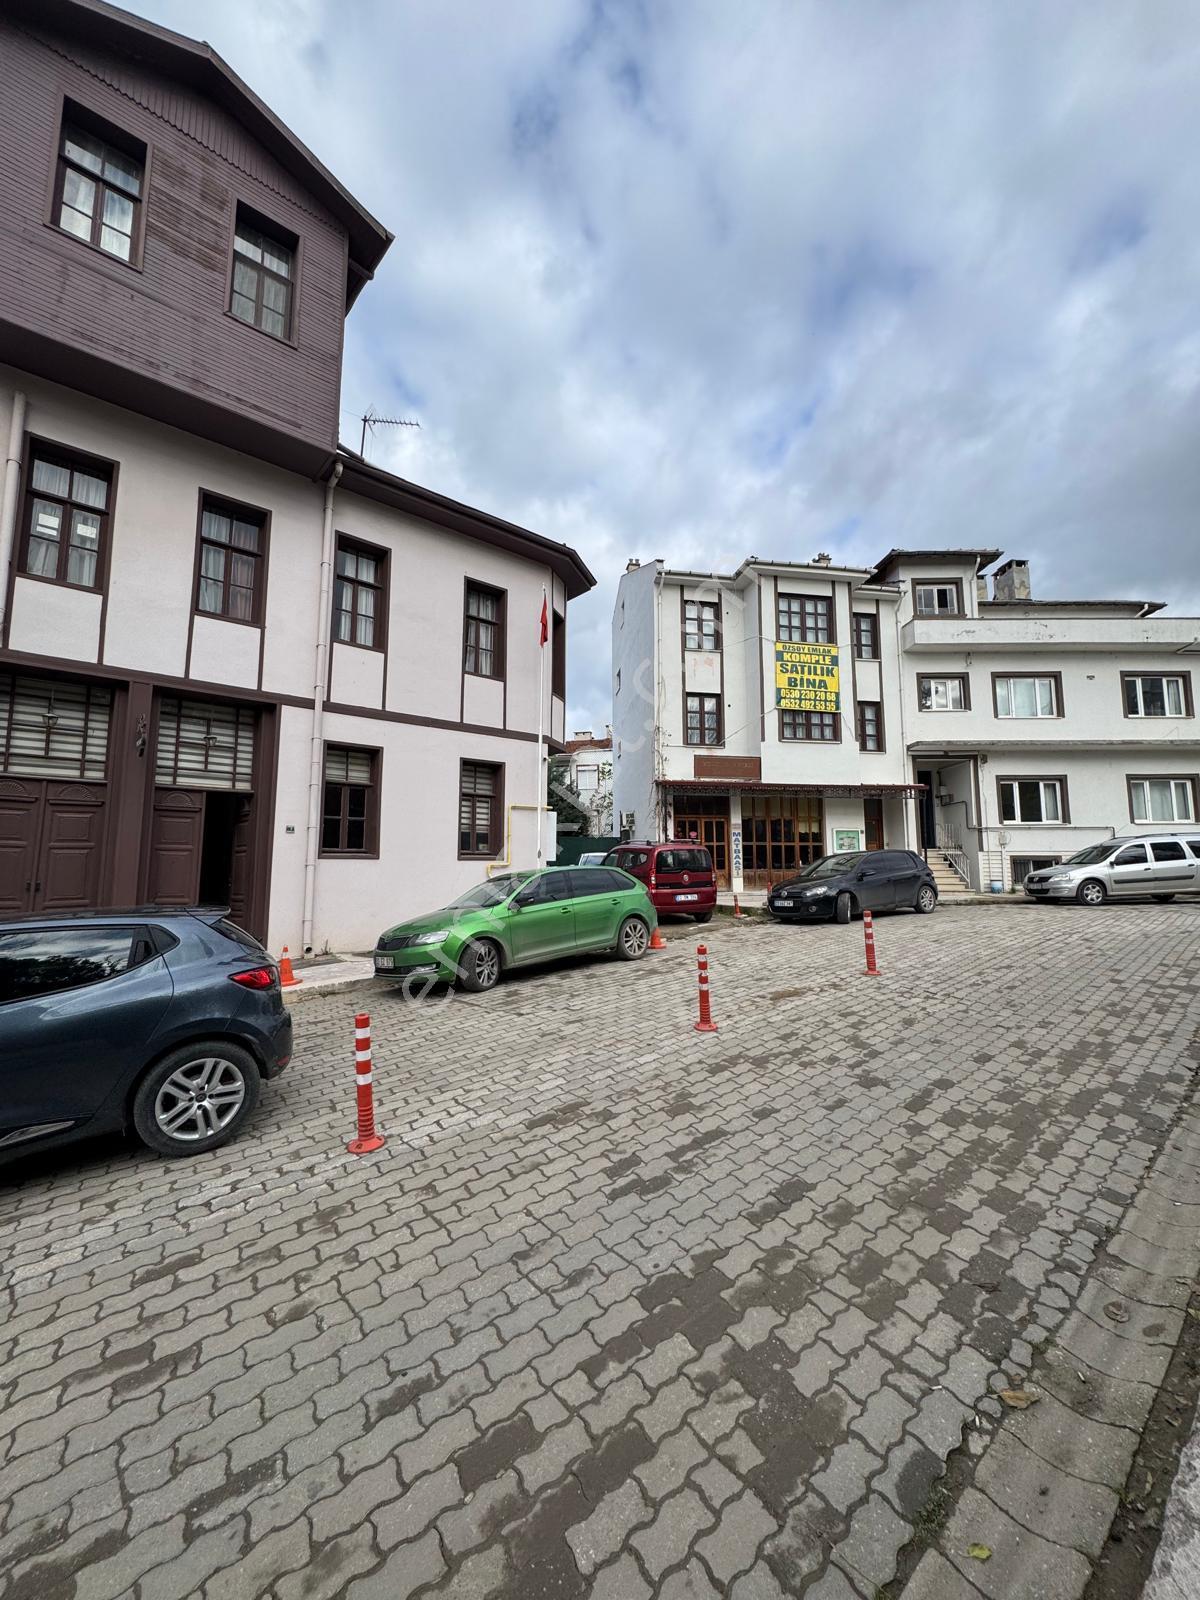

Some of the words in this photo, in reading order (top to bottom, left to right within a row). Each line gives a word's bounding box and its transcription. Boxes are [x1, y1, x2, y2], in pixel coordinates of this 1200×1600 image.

[807, 646, 832, 655] EMLAK
[783, 652, 832, 665] KOMPLE
[780, 663, 835, 677] SATILIK
[787, 676, 828, 690] BİNA
[780, 688, 800, 699] 0530
[801, 690, 815, 700] 230
[816, 691, 825, 701] 20
[780, 698, 800, 708] 0532
